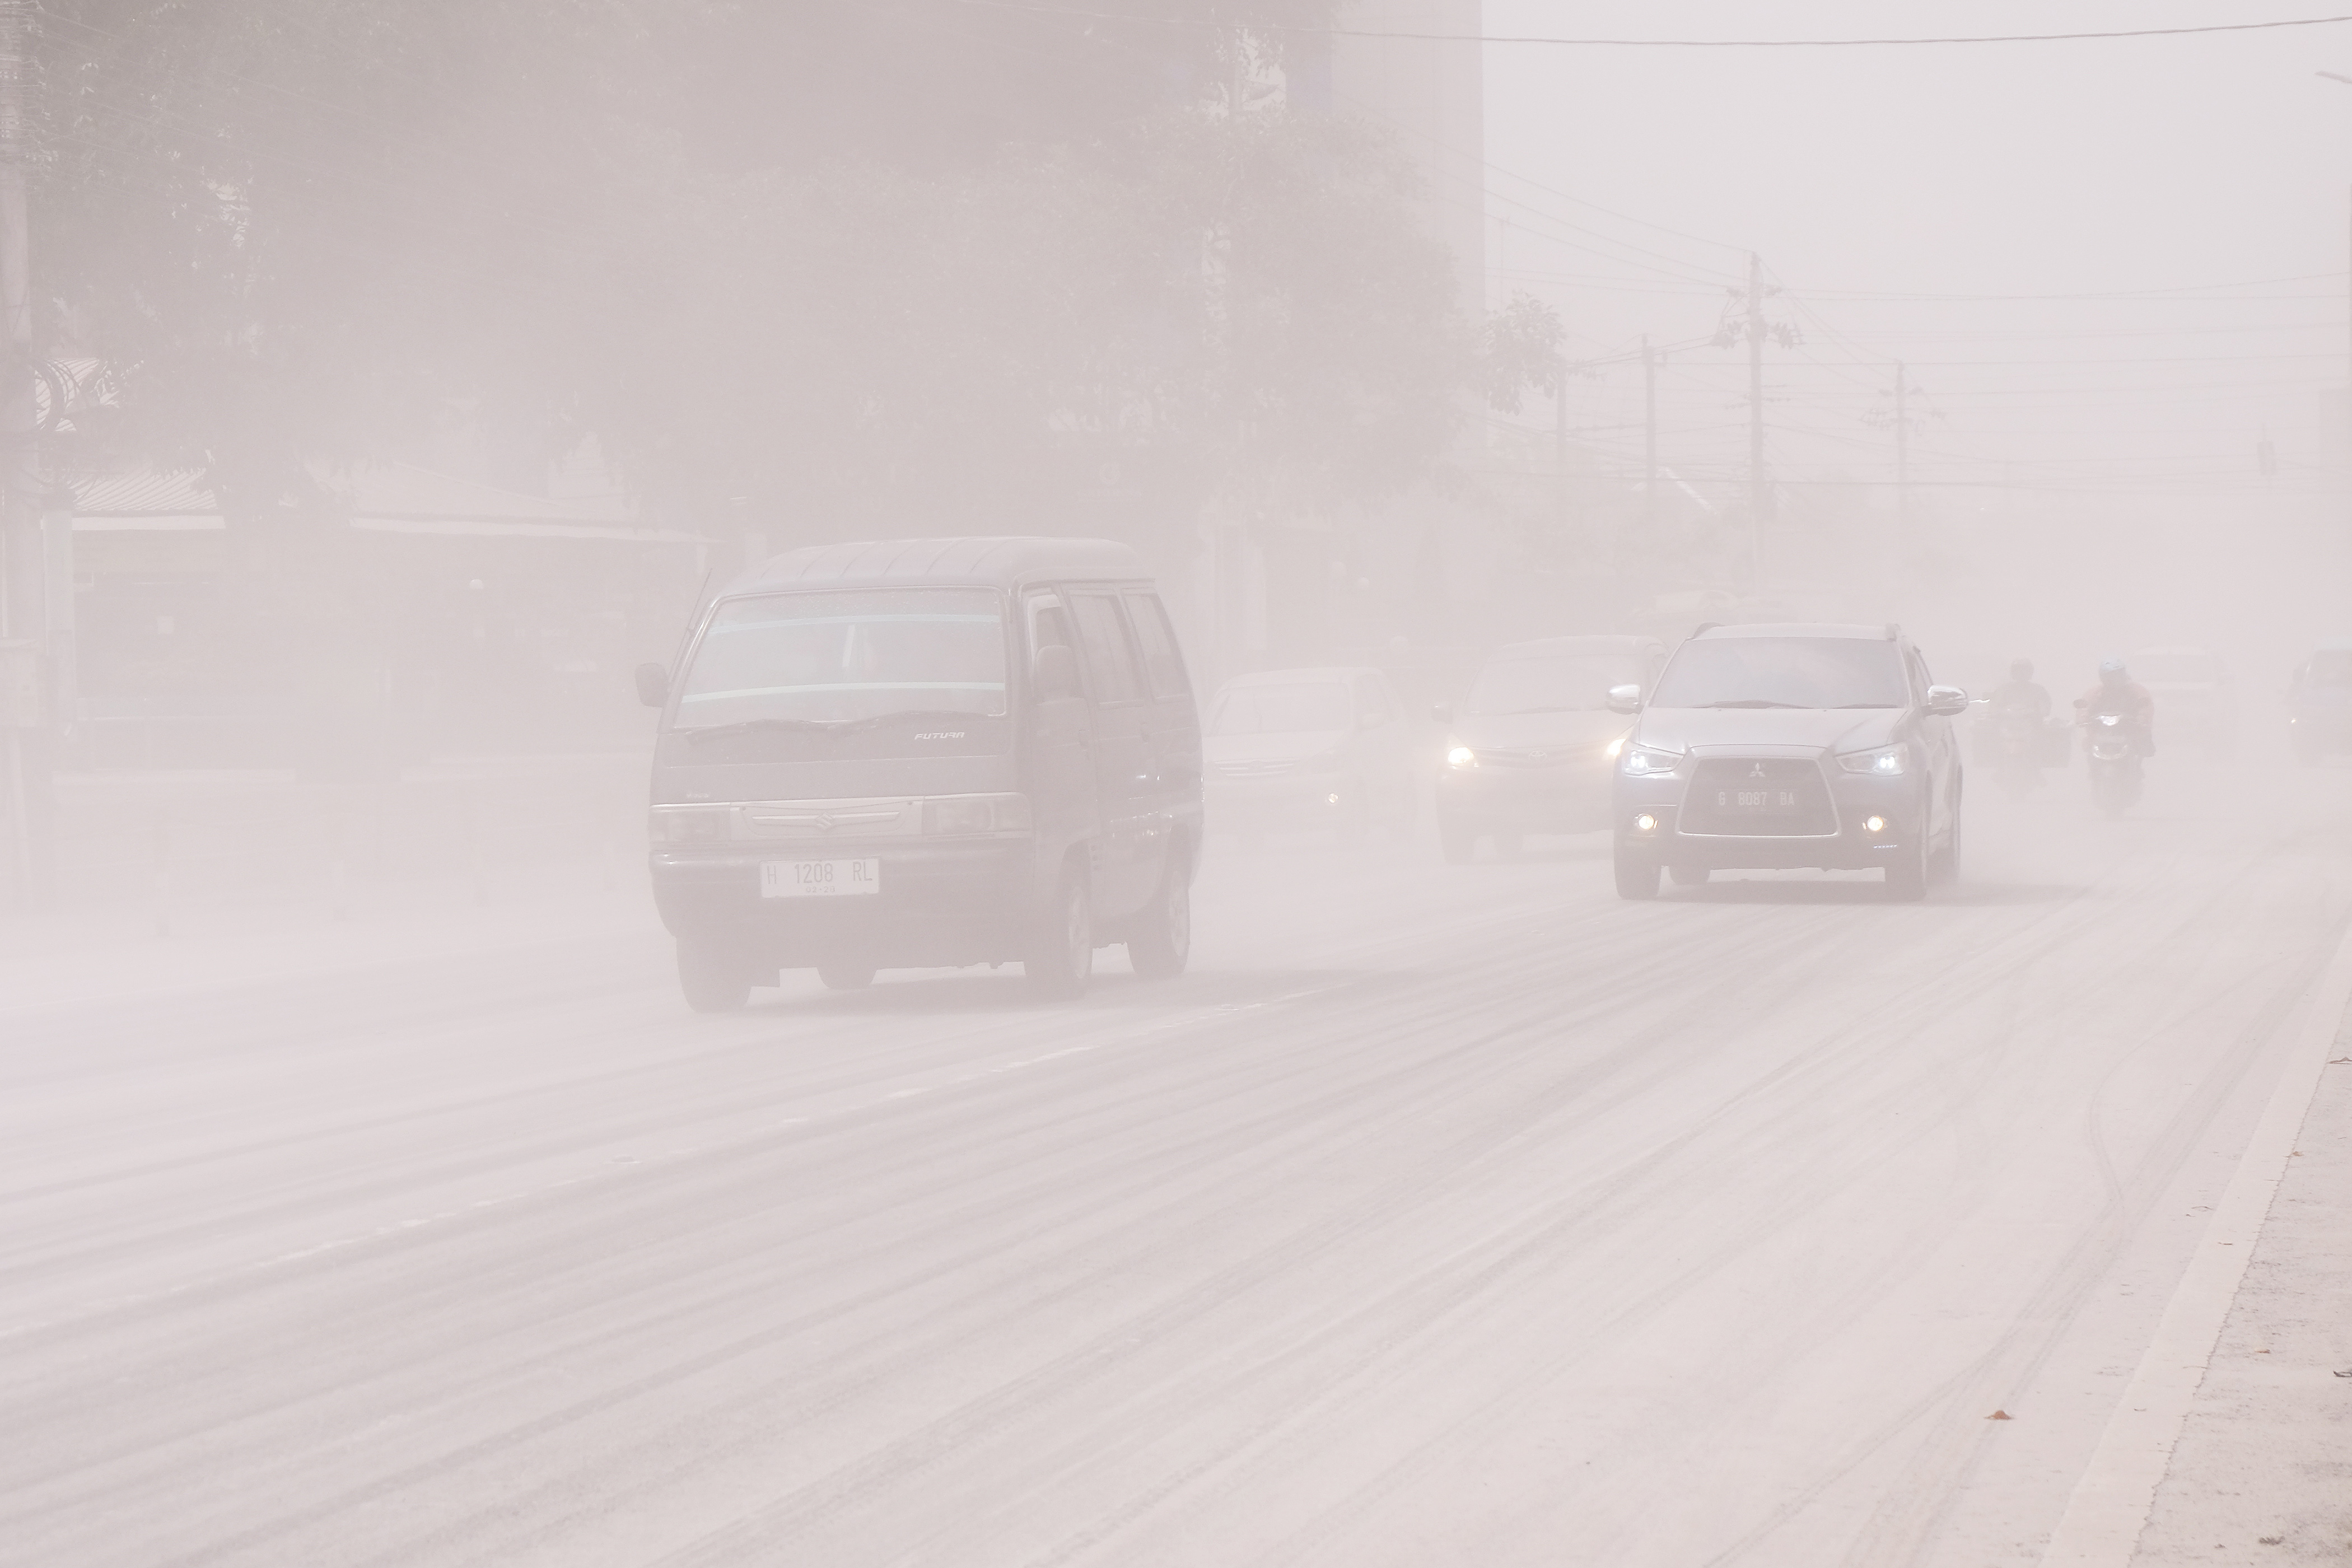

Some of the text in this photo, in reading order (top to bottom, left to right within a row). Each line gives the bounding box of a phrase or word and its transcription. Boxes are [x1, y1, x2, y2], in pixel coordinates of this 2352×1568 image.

[914, 732, 965, 740] FUTURA
[767, 861, 872, 884] H 1208 RL
